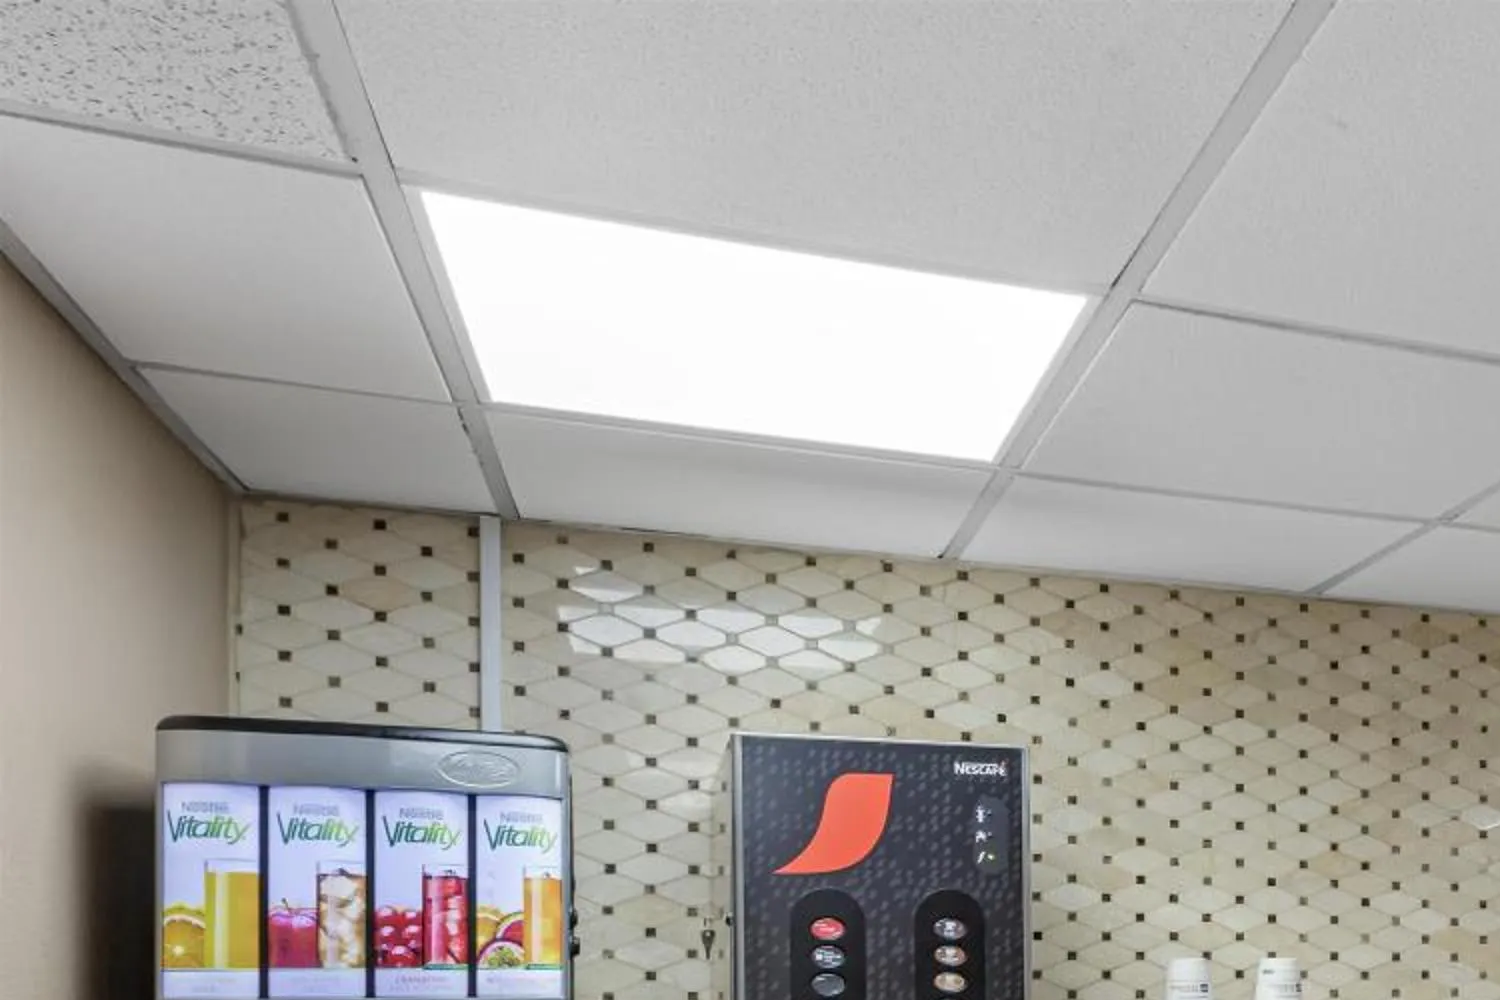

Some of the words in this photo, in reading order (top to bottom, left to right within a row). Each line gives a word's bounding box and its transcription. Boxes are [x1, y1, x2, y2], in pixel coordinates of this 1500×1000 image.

[167, 809, 250, 845] Vitality
[276, 812, 360, 848] Vitality
[383, 815, 461, 851] Vitality
[484, 818, 558, 854] Vitality
